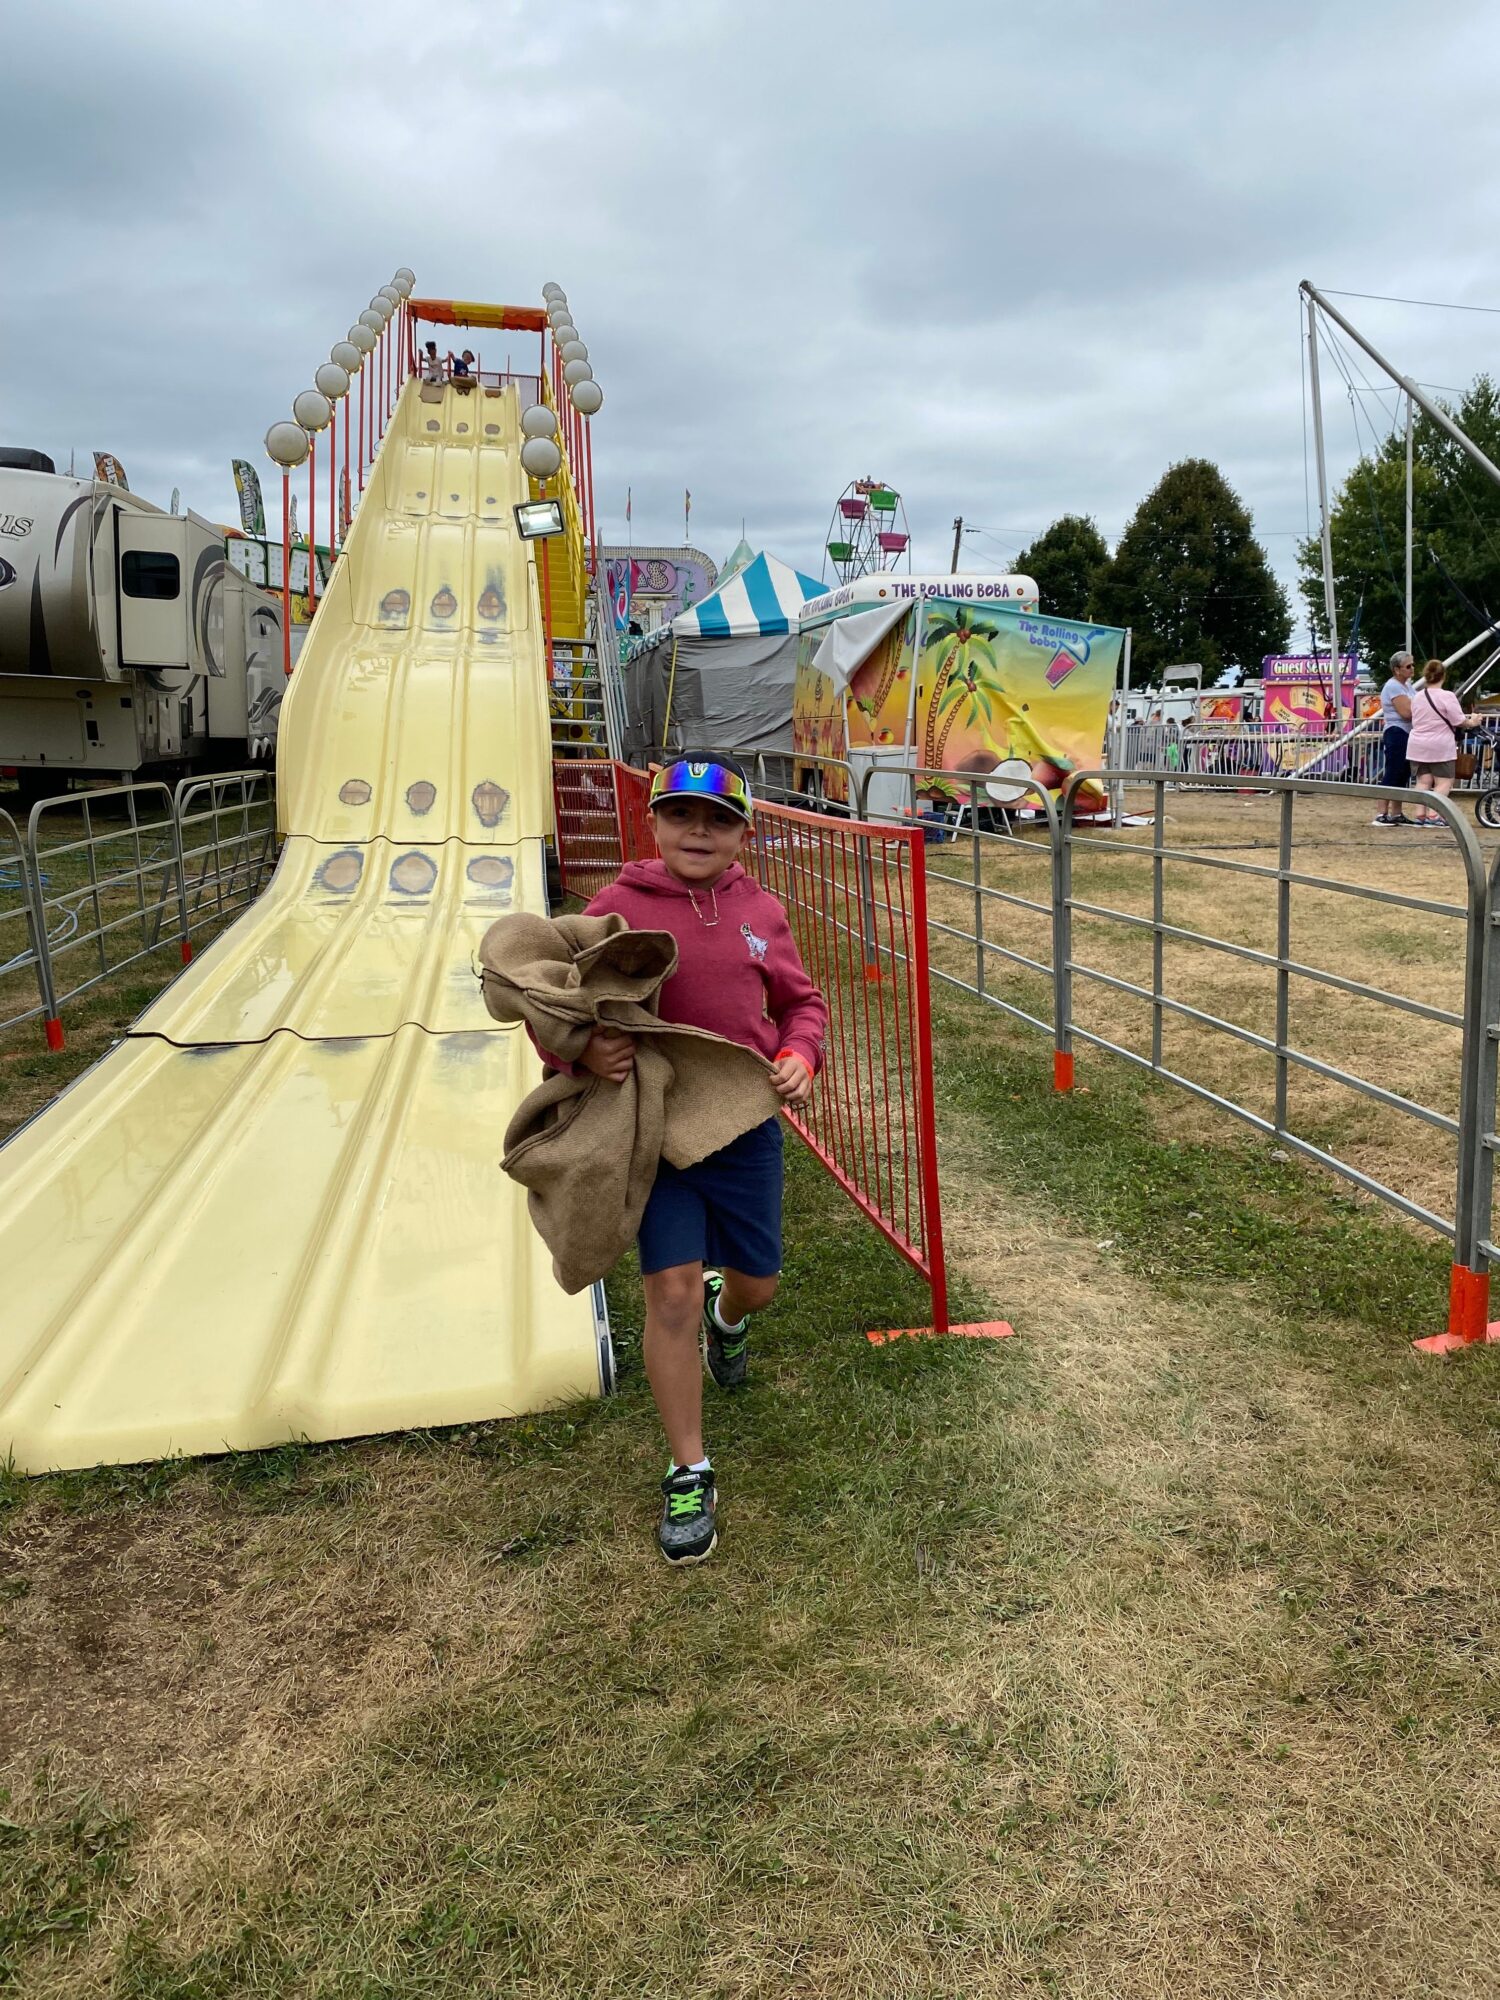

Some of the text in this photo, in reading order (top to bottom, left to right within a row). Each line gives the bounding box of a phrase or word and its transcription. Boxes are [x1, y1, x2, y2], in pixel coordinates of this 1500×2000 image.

[891, 583, 1010, 599] THE ROLLING BOBA
[1018, 620, 1079, 644] The Rolling
[1029, 633, 1057, 649] boba
[1273, 660, 1350, 675] Guest Servies
